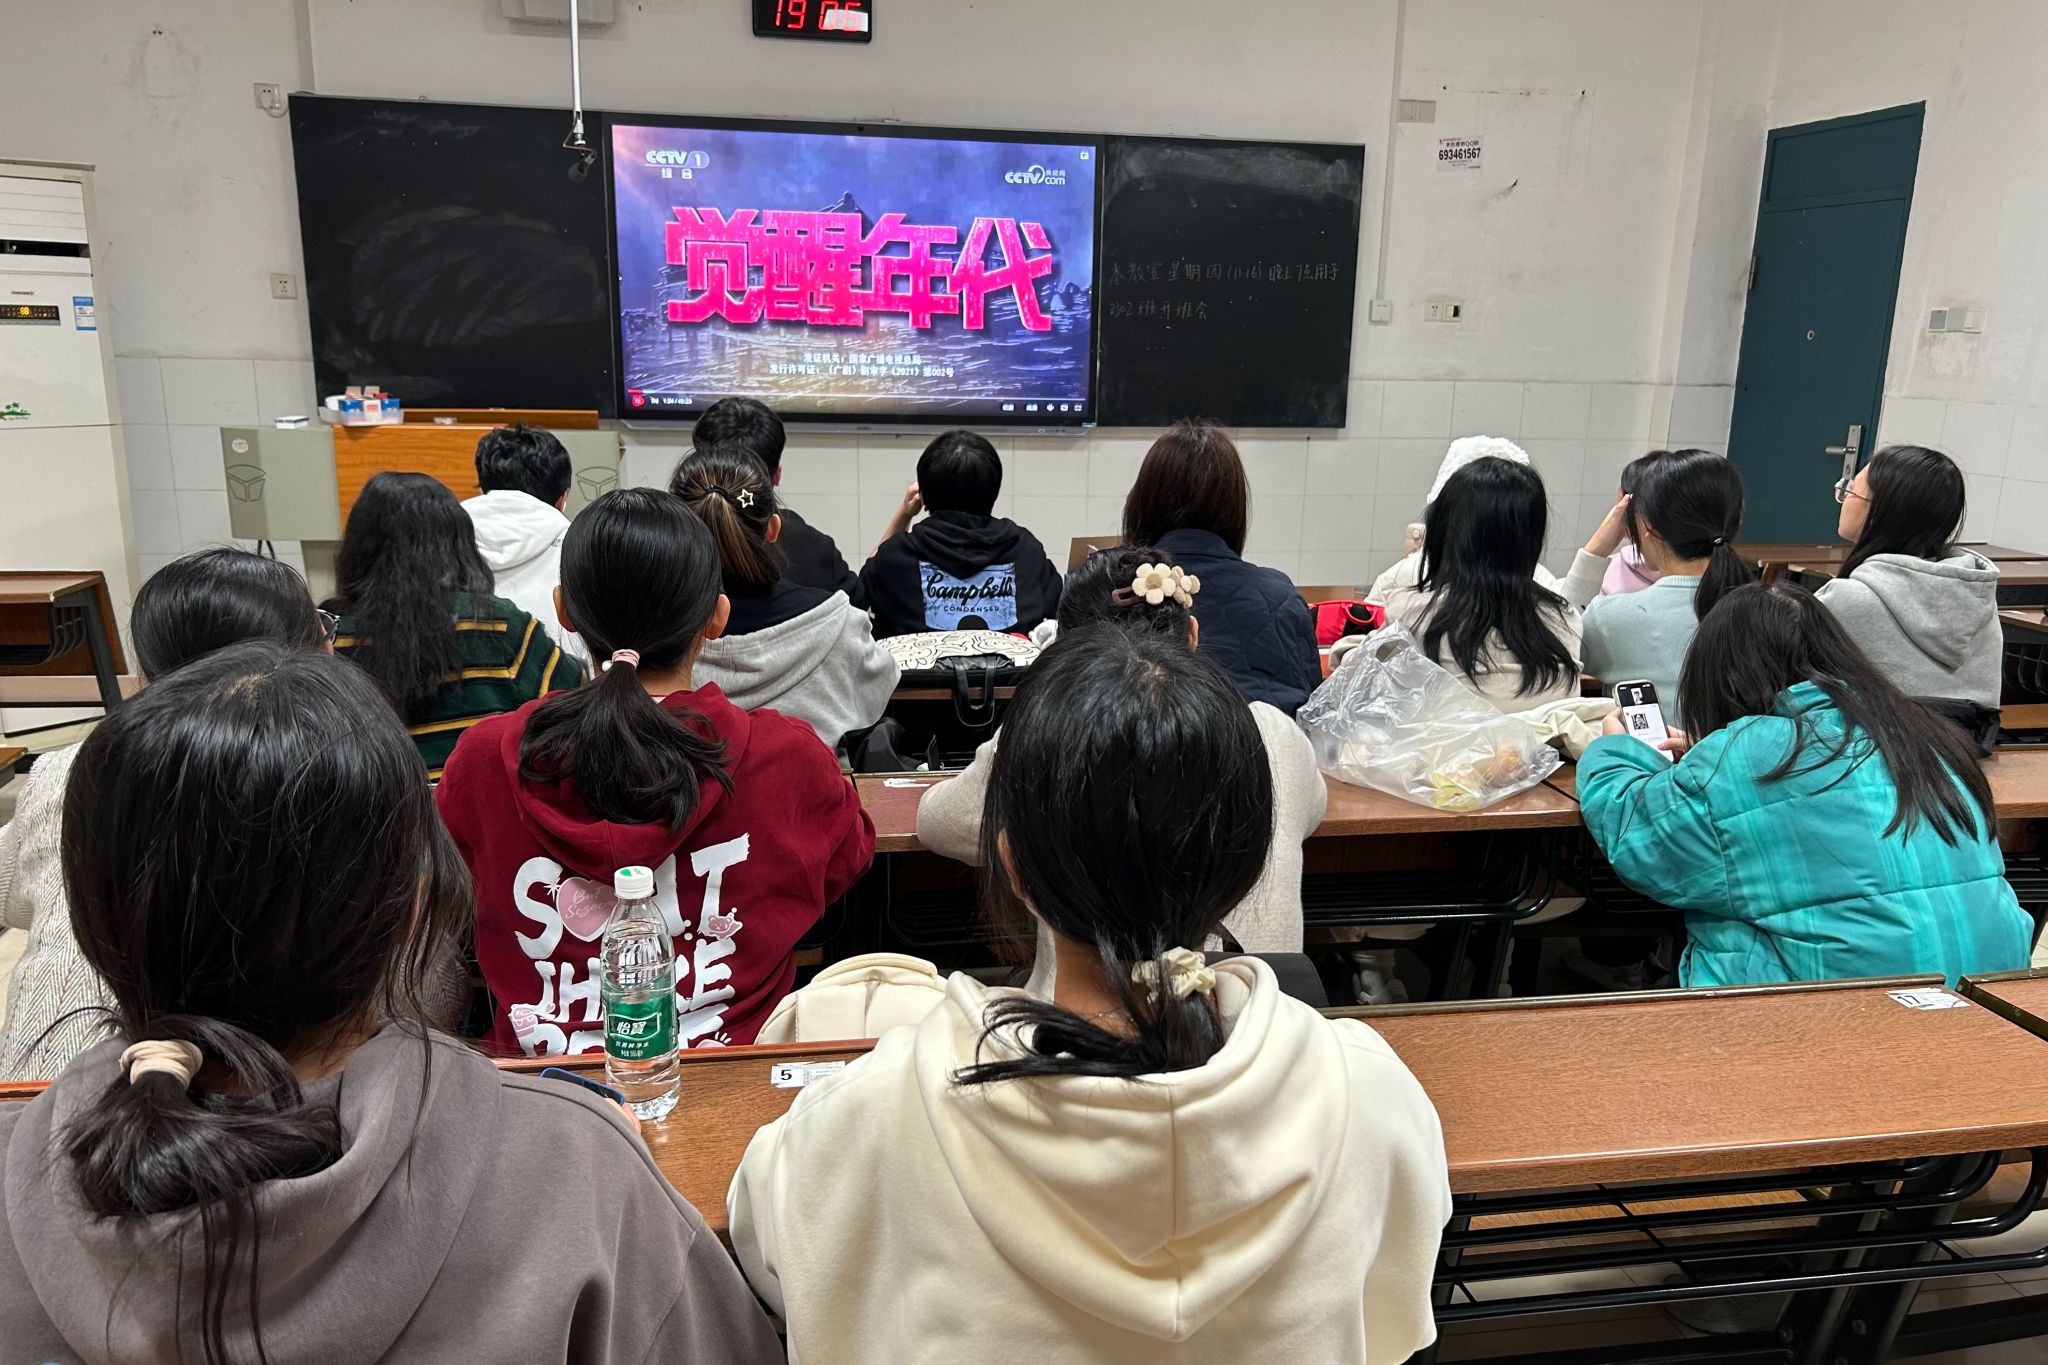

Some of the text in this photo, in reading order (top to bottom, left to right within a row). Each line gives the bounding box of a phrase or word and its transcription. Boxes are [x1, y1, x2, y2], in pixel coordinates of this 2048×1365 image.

[645, 150, 687, 165] CCTV
[1438, 147, 1481, 161] 693461567
[1004, 167, 1043, 184] CCTV
[665, 206, 1052, 331] 觉醒年代
[943, 605, 1000, 613] CONDENSED
[780, 1069, 793, 1081] 5
